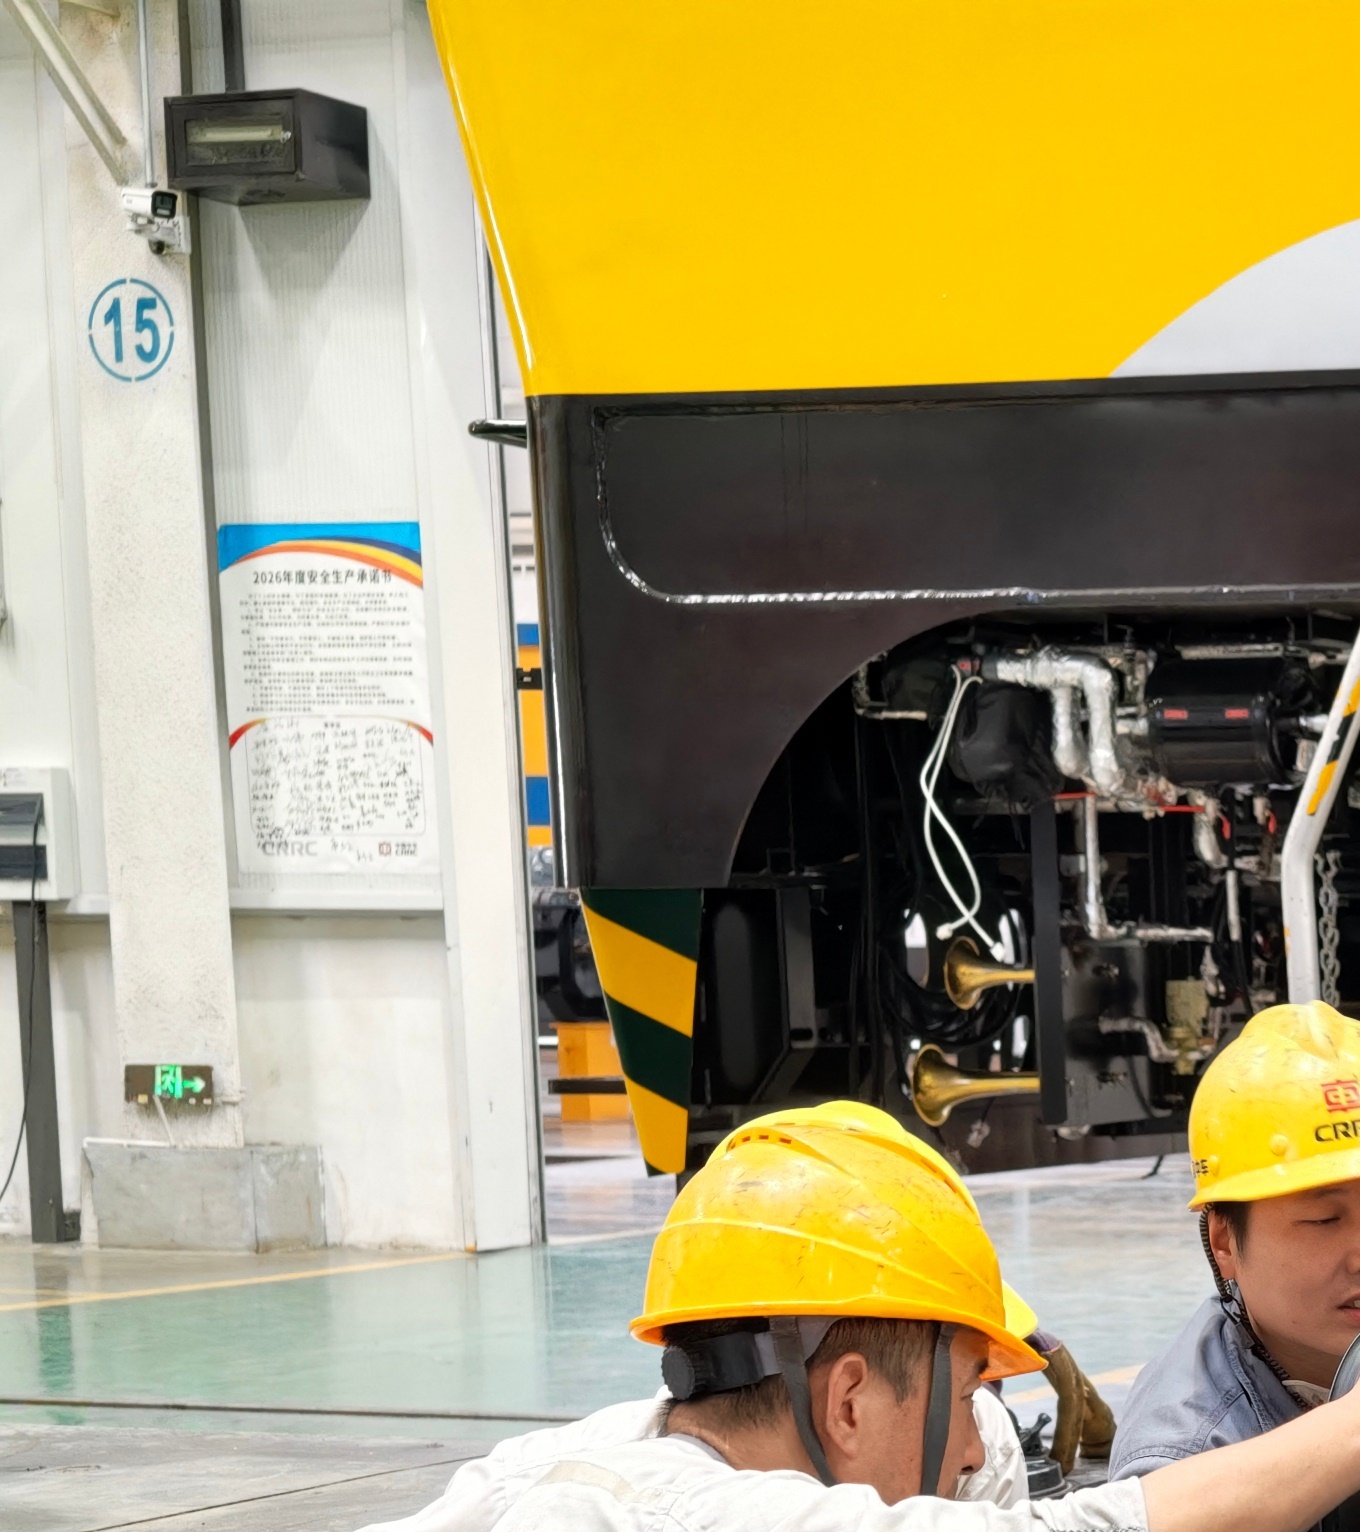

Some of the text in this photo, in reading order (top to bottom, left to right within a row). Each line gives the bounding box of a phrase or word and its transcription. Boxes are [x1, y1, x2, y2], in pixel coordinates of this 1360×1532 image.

[104, 297, 160, 363] 15
[253, 568, 392, 585] 2026年度安全生产承诺书
